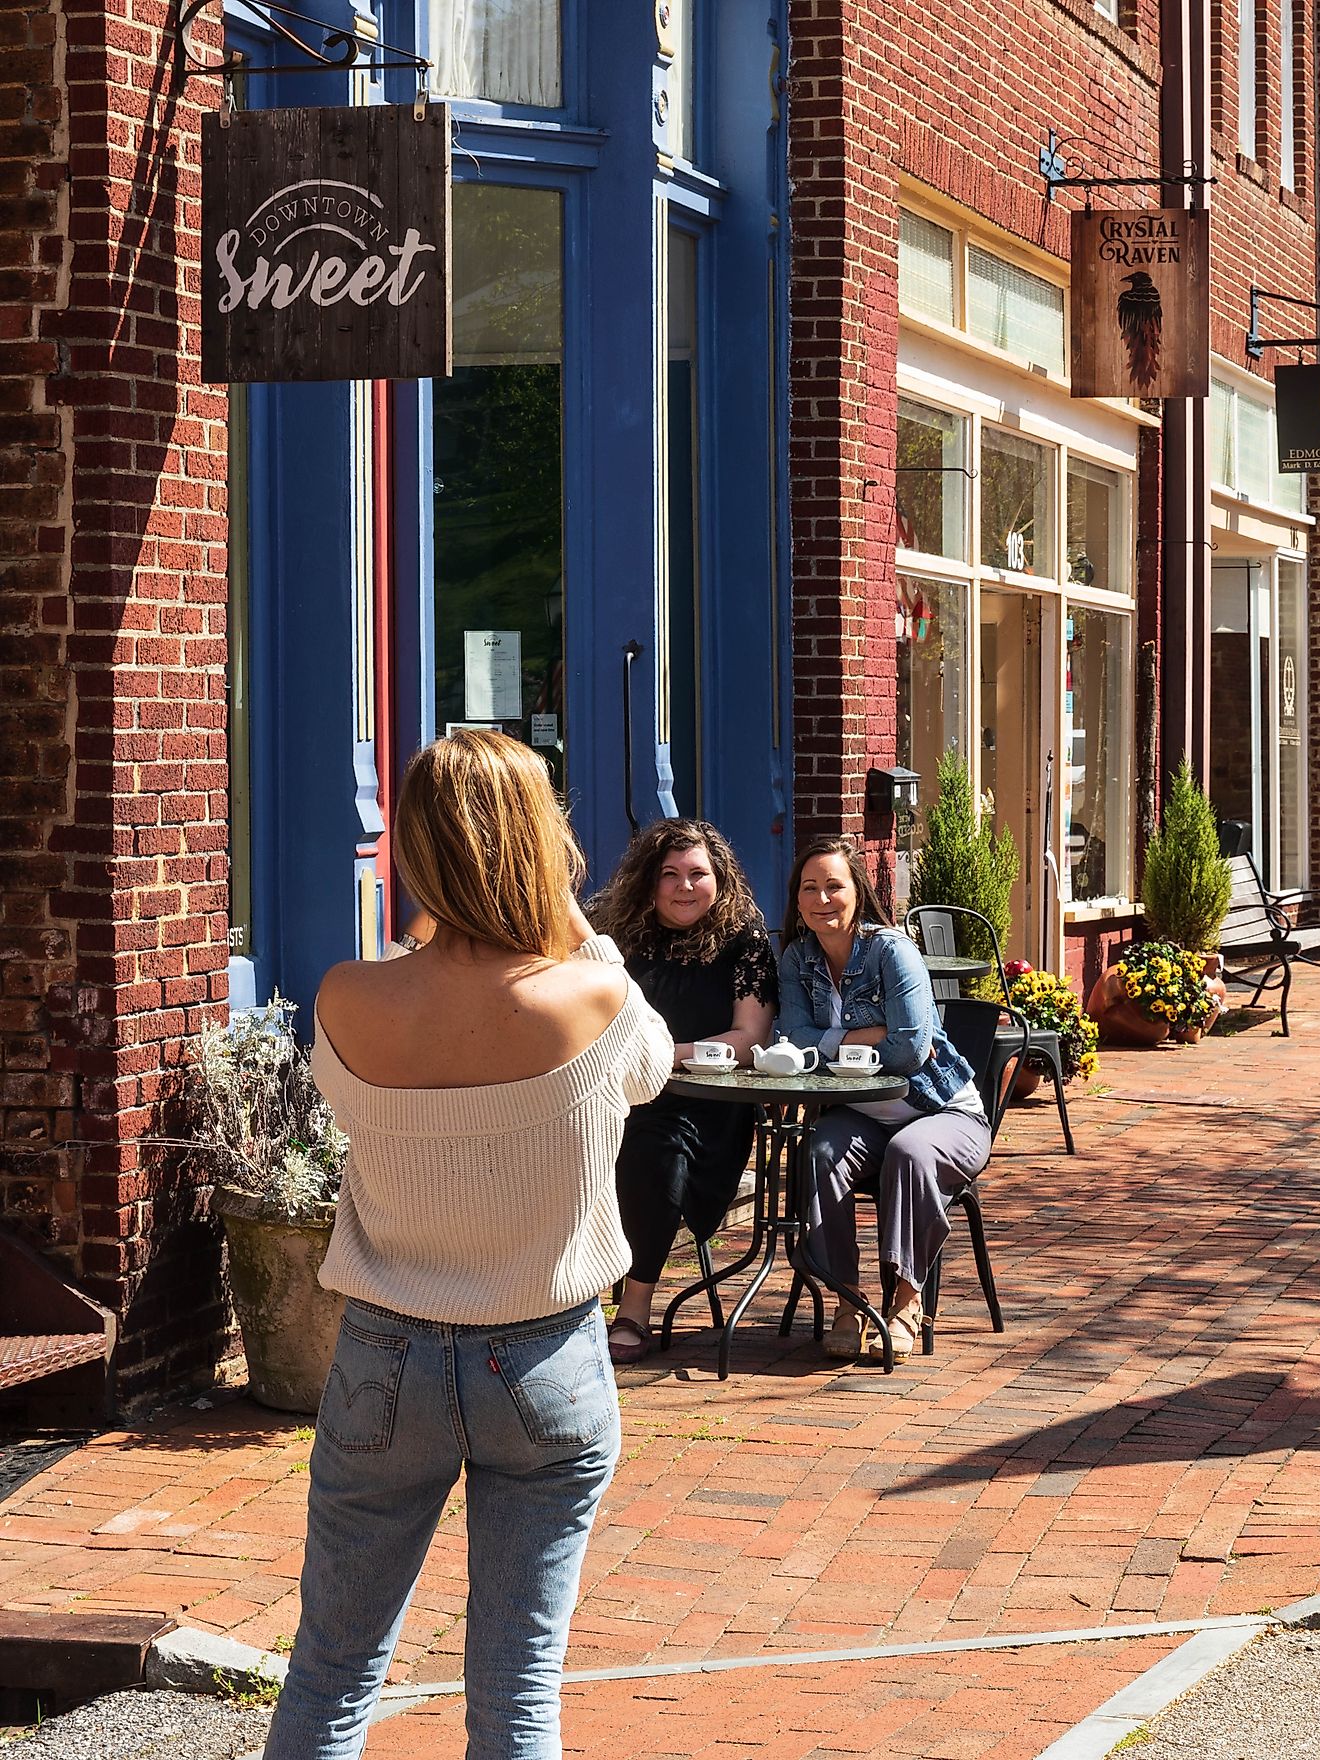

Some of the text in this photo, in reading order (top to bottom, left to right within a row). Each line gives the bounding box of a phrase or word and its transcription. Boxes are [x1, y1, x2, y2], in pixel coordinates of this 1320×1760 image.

[249, 196, 390, 248] DOWNTOWN
[1100, 215, 1180, 240] CRYSTAL
[215, 228, 437, 313] Sweet
[1099, 238, 1181, 268] RAVEN
[1006, 531, 1025, 570] 103
